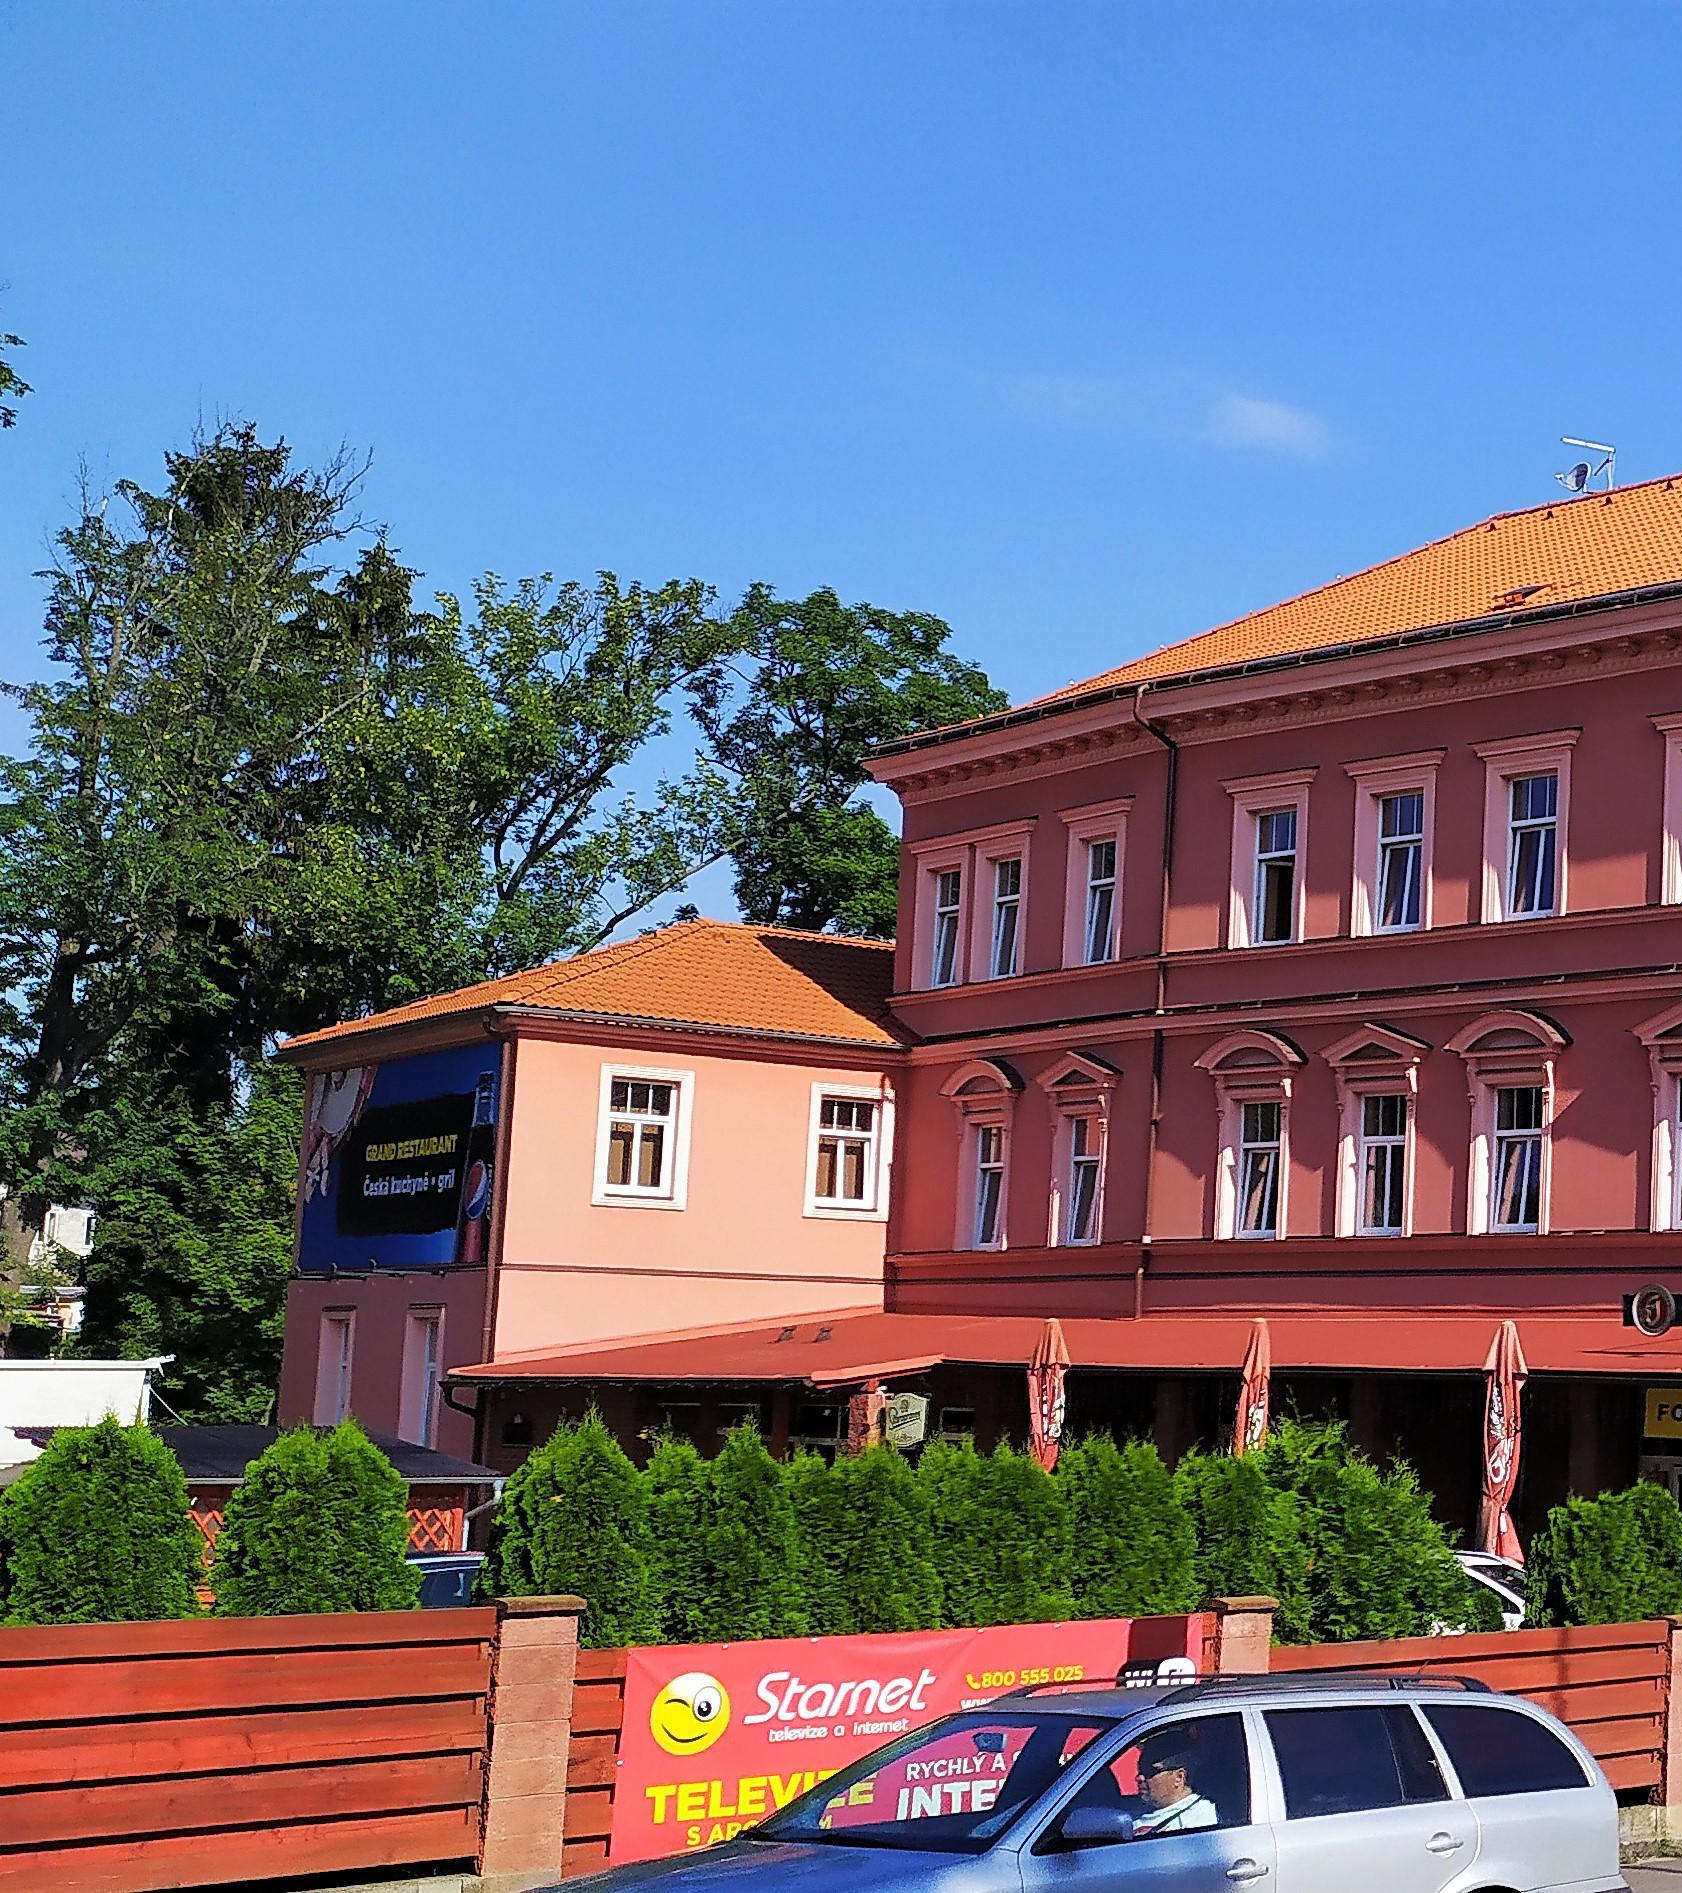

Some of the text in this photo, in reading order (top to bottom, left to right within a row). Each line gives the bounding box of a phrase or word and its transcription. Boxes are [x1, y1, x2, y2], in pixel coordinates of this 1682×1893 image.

[366, 1134, 458, 1161] GRAND RESTAURANT
[981, 1665, 1083, 1688] 800 555 025
[743, 1669, 936, 1724] Starnet
[769, 1724, 828, 1743] televize
[834, 1725, 845, 1736] a
[992, 1753, 1006, 1771] A
[686, 1825, 701, 1846] S
